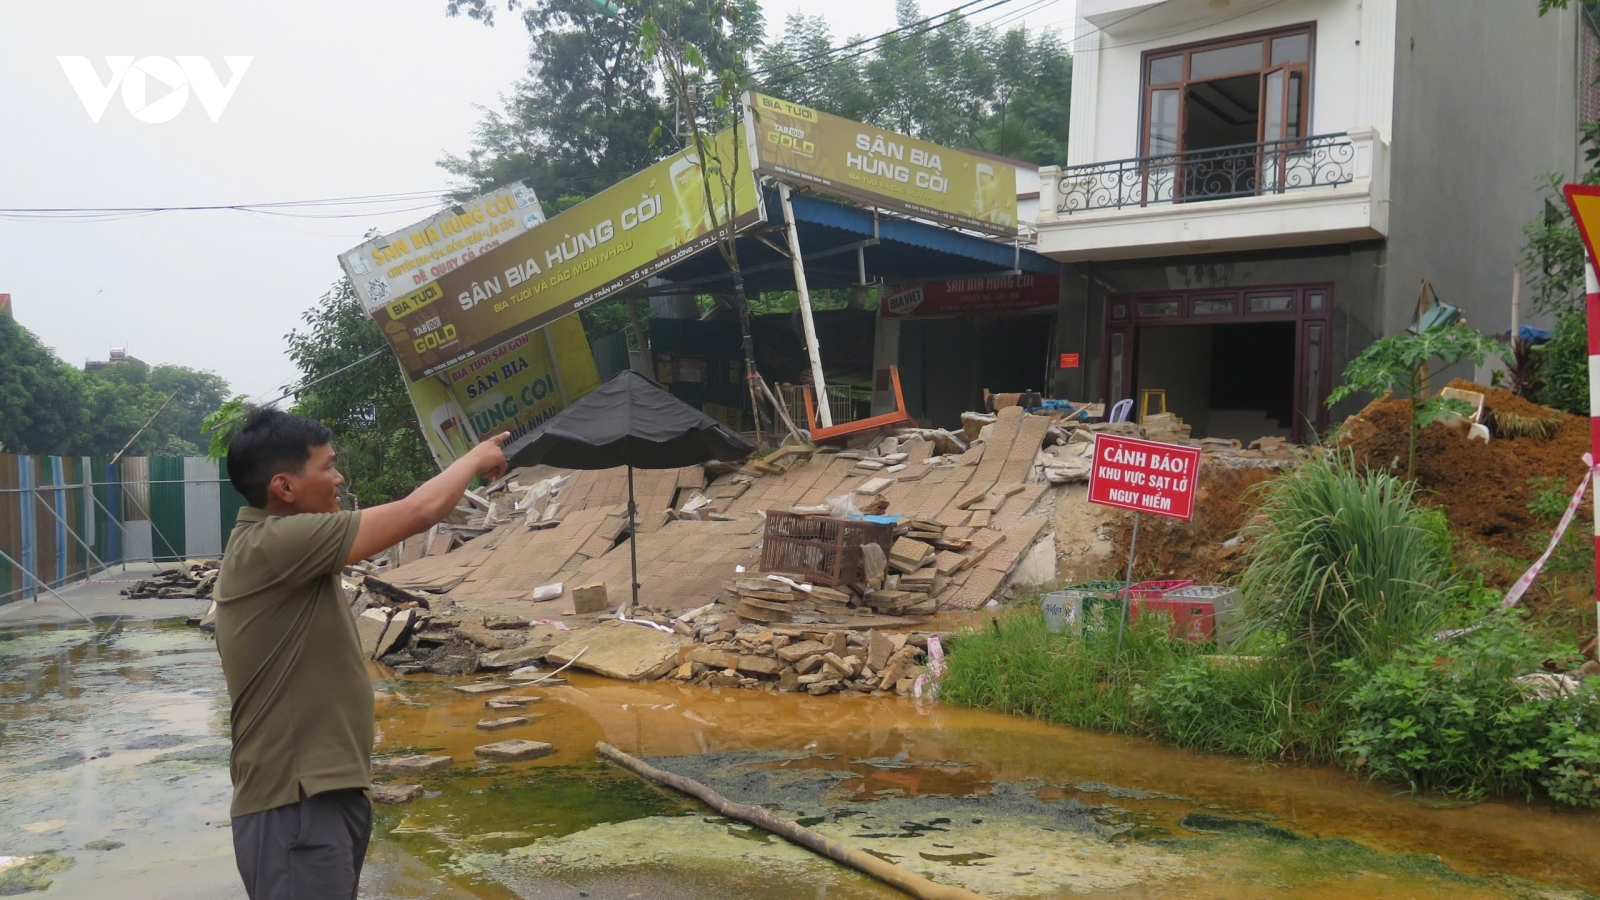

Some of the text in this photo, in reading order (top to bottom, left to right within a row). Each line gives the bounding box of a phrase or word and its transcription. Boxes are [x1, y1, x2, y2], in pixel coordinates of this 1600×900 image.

[762, 98, 782, 111] BIA
[767, 131, 815, 154] GOLD
[855, 133, 943, 171] SÂN BIA
[846, 151, 911, 184] HÙNG
[915, 171, 949, 194] CÒI
[410, 225, 440, 250] BIA
[486, 192, 516, 218] CÒI
[458, 192, 662, 311] SÂN BIA HÙNG CÒI
[412, 269, 429, 285] DÊ
[430, 257, 461, 277] QUAY
[493, 300, 510, 313] BIA
[533, 279, 549, 294] VÀ
[549, 270, 572, 287] CÁC
[572, 257, 599, 276] MÓN
[600, 239, 634, 262] NHẬU
[631, 270, 640, 281] TỔ
[641, 268, 649, 276] 12
[654, 258, 671, 269] NAM
[967, 277, 984, 291] BIA
[392, 303, 411, 316] BIA
[890, 296, 904, 310] BIA
[413, 323, 457, 354] GOLD
[451, 368, 469, 381] BIA
[466, 371, 499, 399] SÂN
[501, 356, 530, 380] BIA
[1103, 443, 1189, 474] CẢNH BÁO!
[1098, 466, 1188, 492] KHU VỰC SẠT LỞ
[1109, 488, 1172, 510] NGUY HIỂM
[1045, 603, 1062, 615] Tiger
